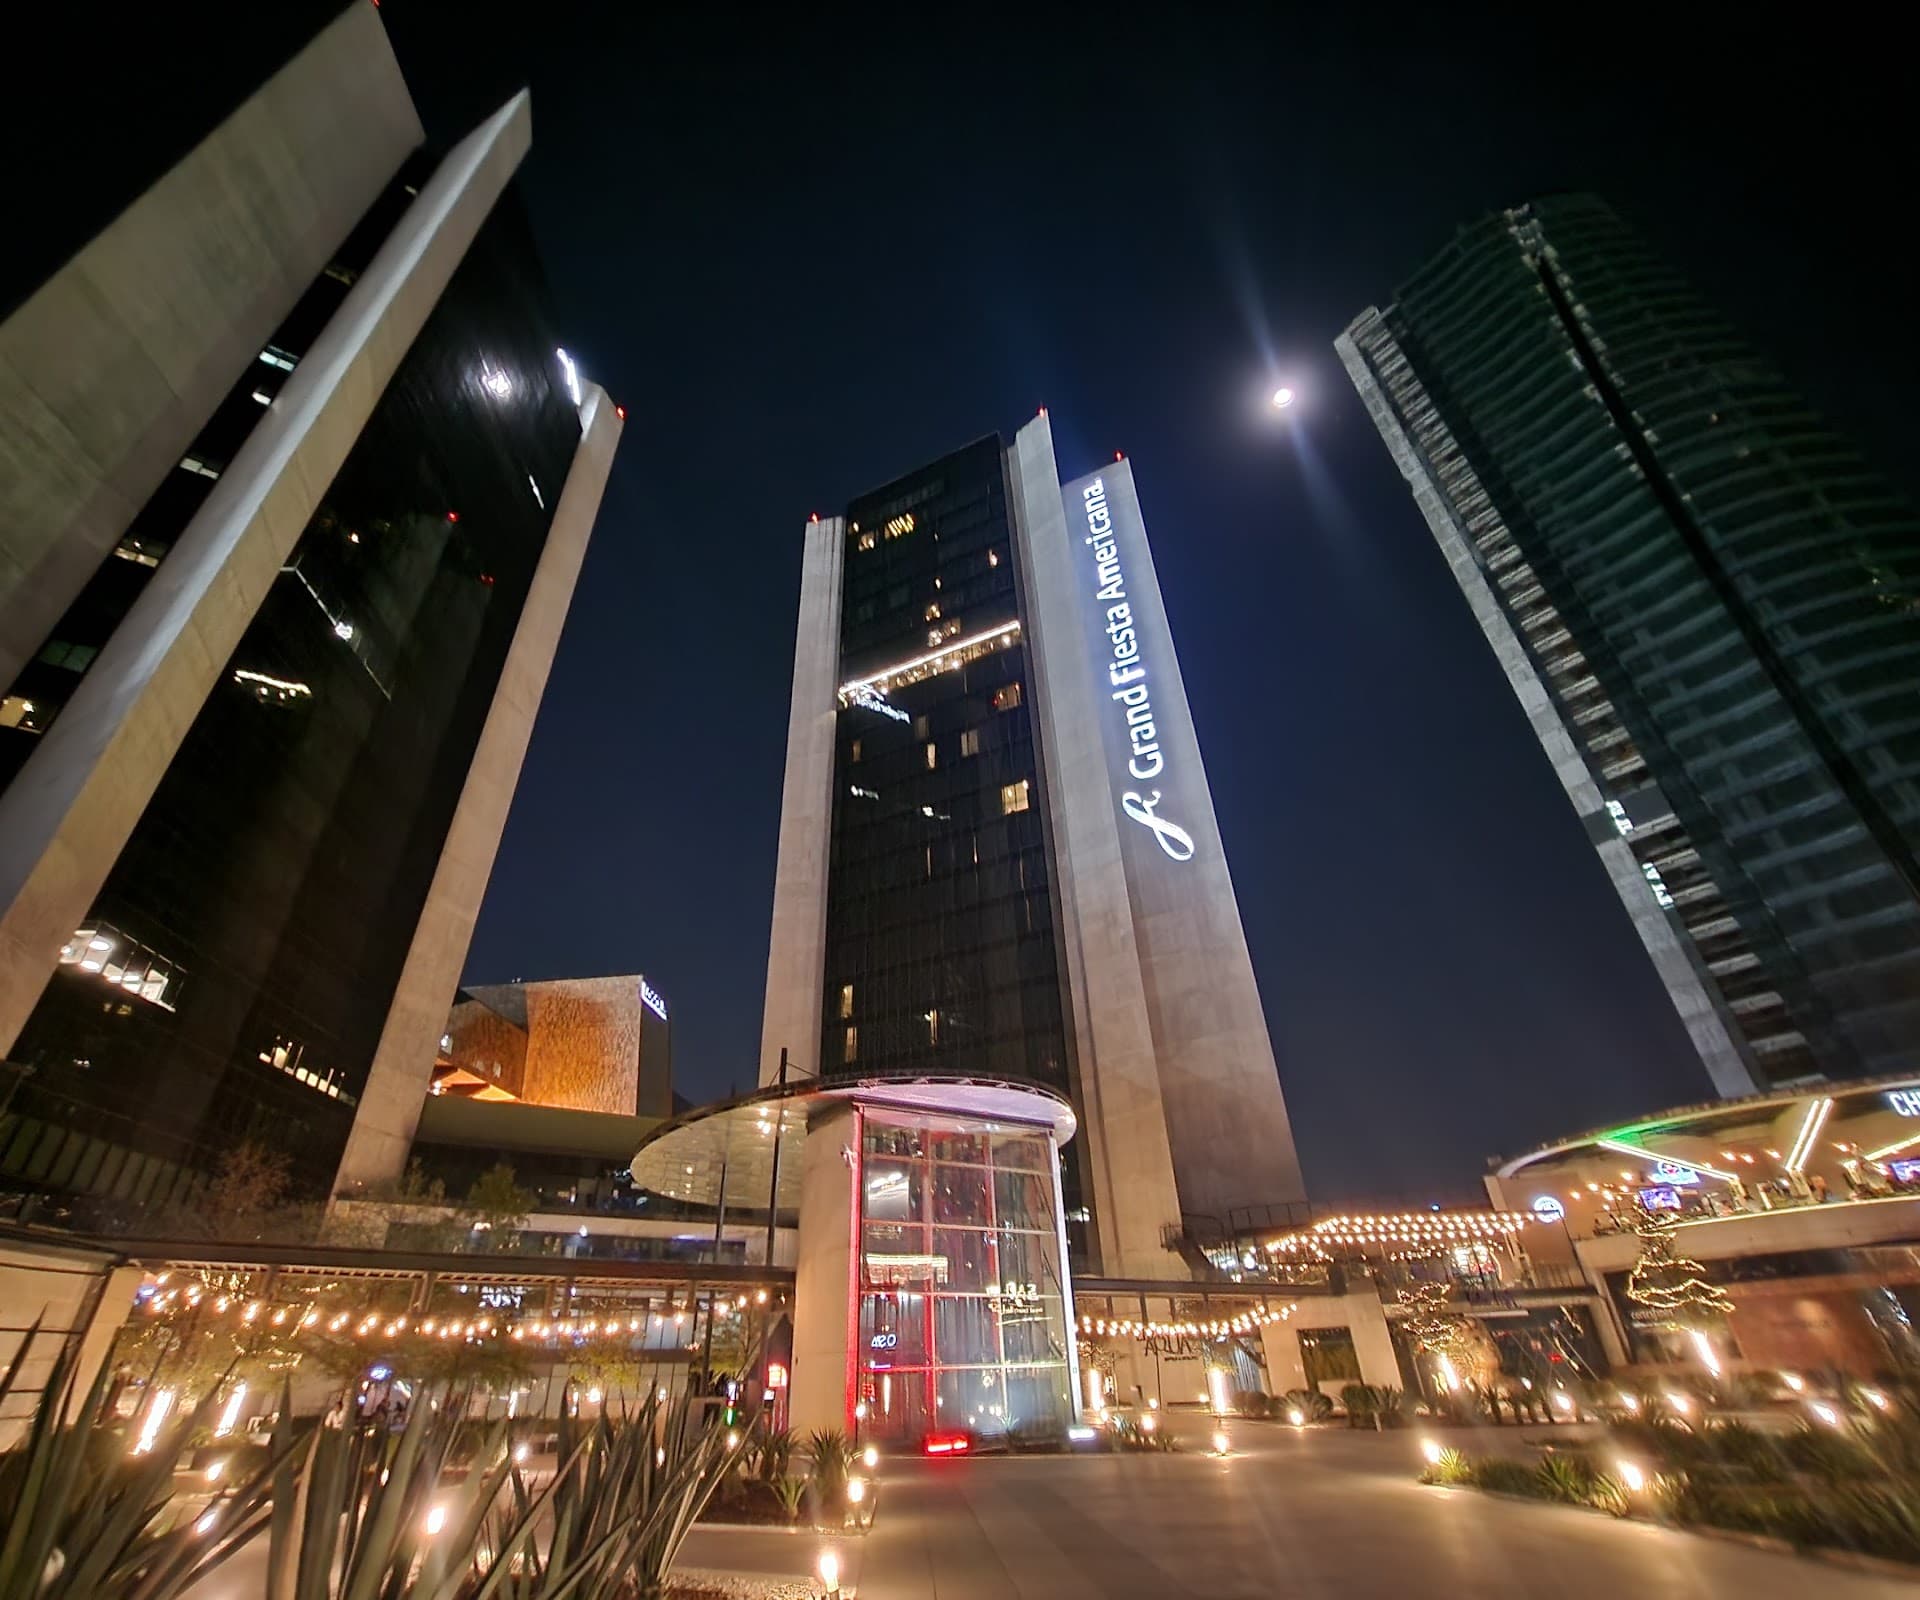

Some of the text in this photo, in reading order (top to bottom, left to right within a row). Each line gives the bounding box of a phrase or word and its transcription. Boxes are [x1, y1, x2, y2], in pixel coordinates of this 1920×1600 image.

[1083, 478, 1164, 779] Grand Fiesta Americana
[1889, 1091, 1920, 1117] CH
